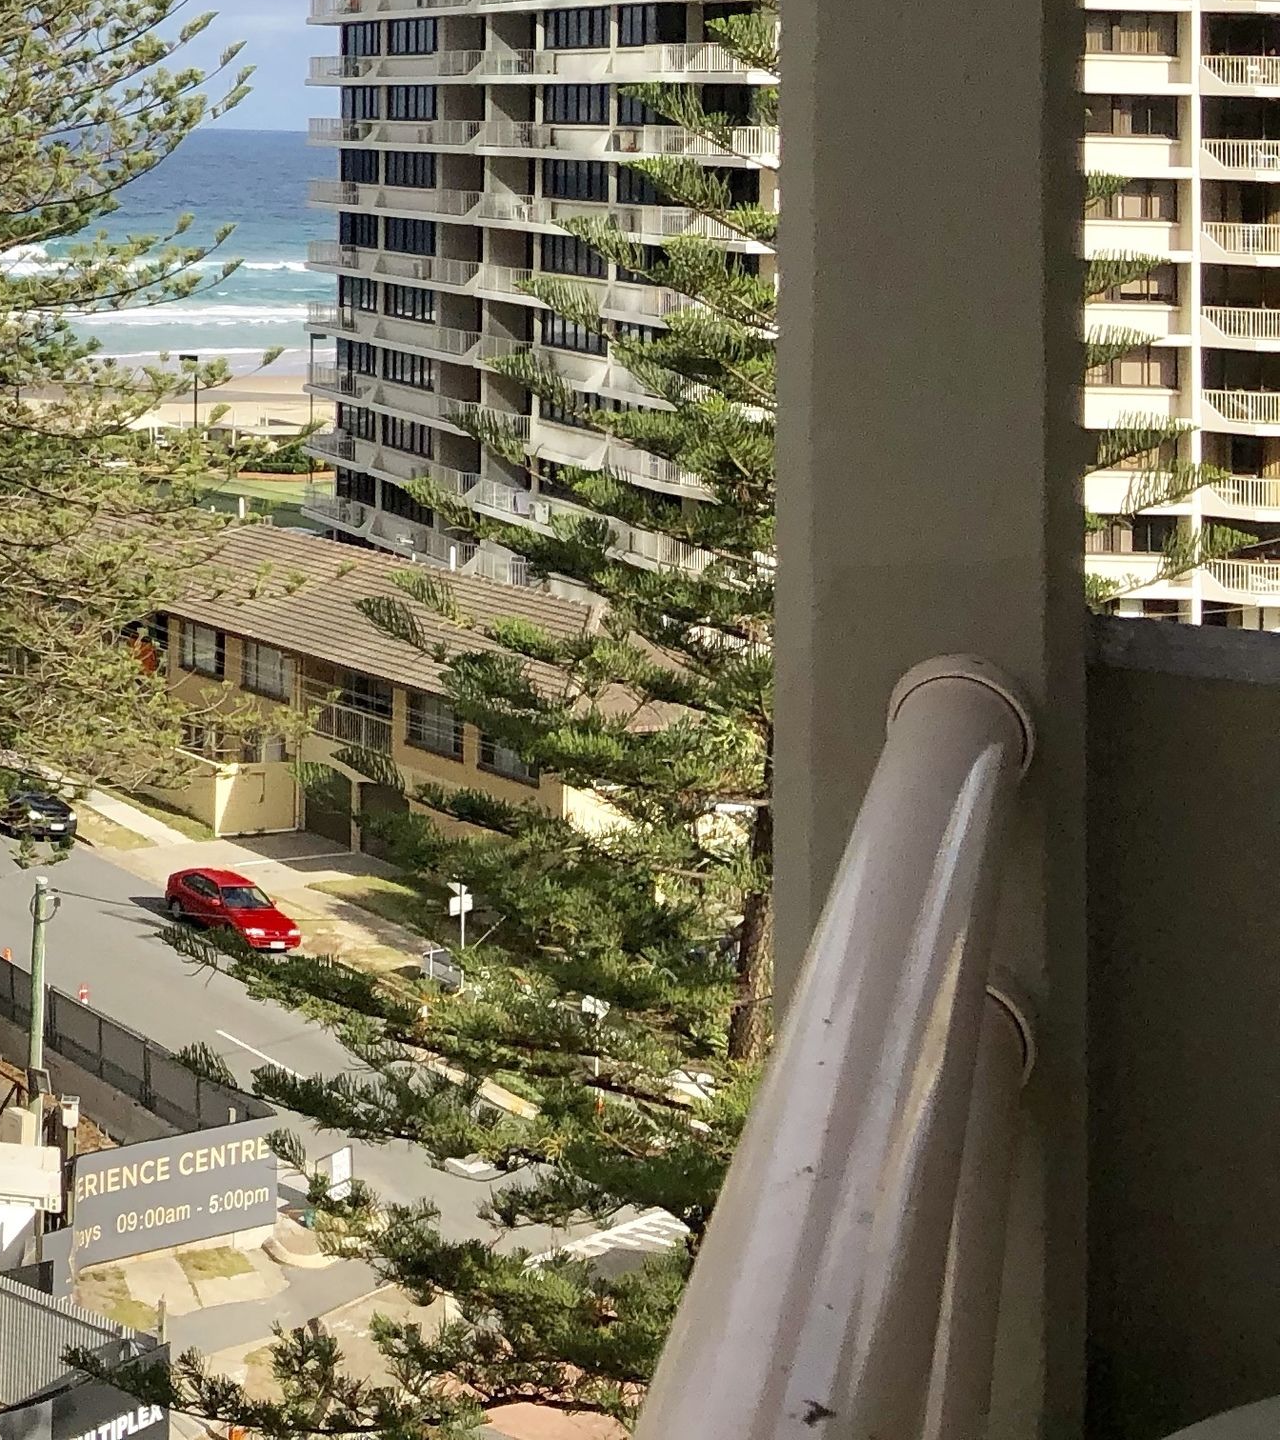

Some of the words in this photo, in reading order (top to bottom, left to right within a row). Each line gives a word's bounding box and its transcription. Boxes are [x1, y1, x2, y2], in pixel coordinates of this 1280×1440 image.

[77, 1156, 170, 1203] ERIENCE
[179, 1137, 270, 1175] CENTRE
[116, 1204, 191, 1234] 09:00am
[209, 1187, 269, 1214] 5:00pm
